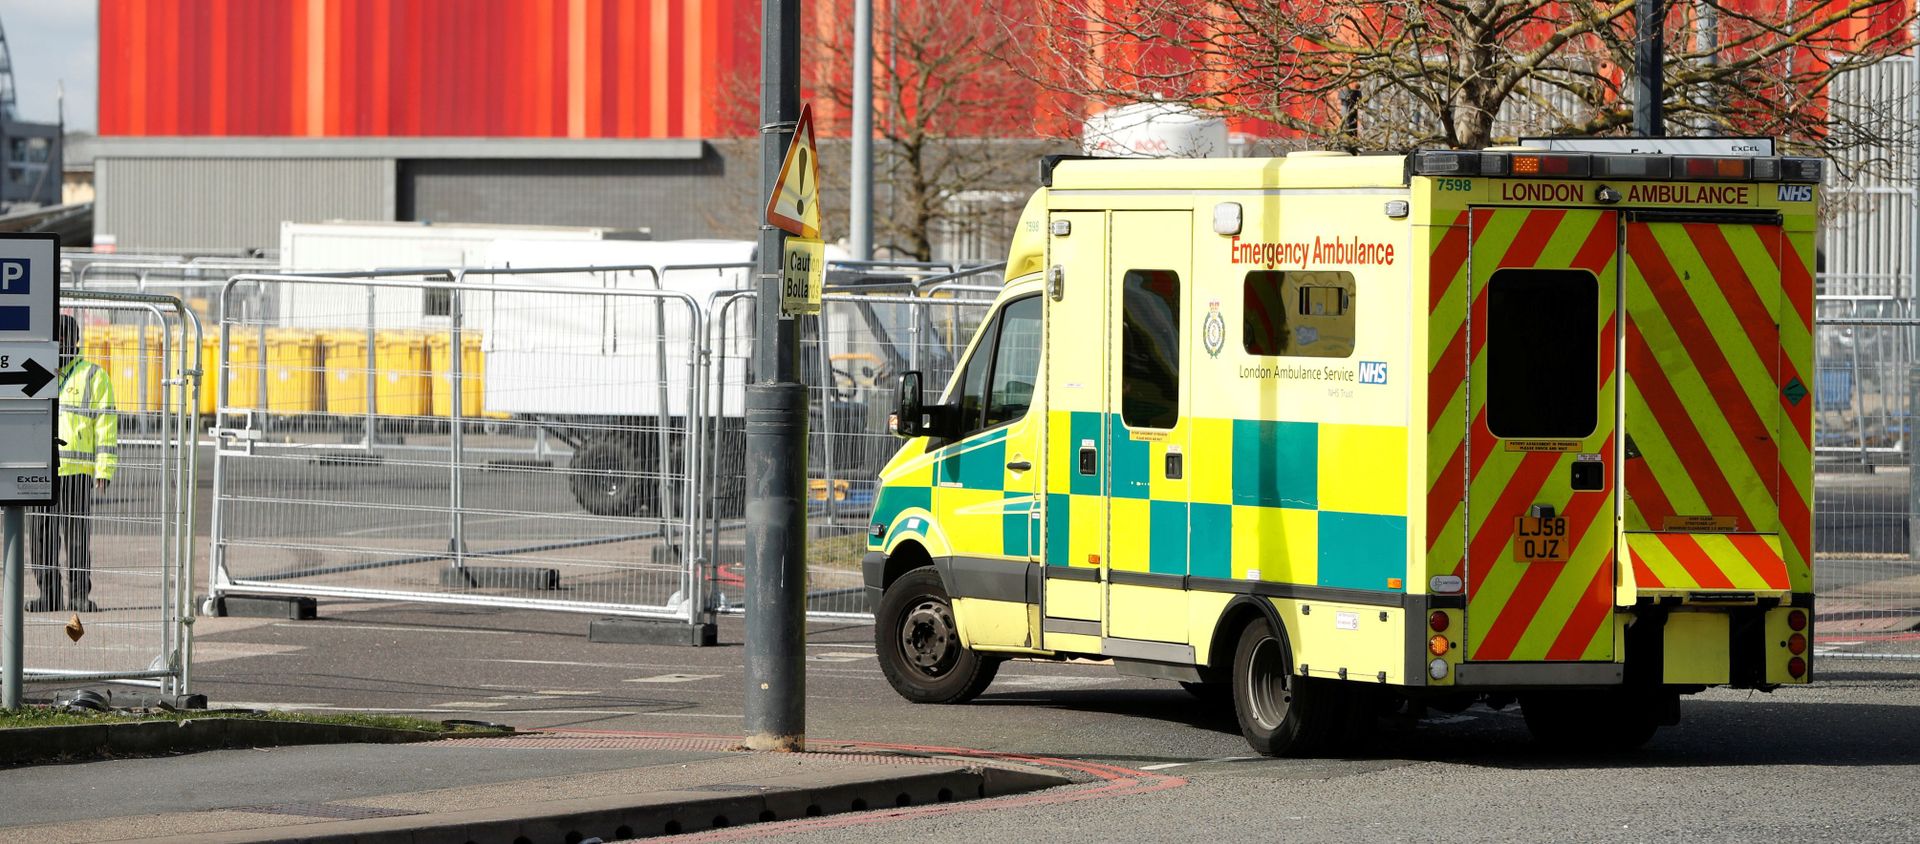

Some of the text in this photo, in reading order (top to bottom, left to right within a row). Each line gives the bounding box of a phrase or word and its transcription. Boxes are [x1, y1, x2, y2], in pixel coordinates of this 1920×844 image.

[1437, 178, 1472, 192] 7598
[1502, 182, 1749, 205] LONDON AMBULANCE
[1777, 185, 1812, 201] NHS
[1231, 235, 1394, 270] Emergency Ambulance
[1239, 364, 1354, 382] London Ambulance Service
[1358, 362, 1387, 384] NHS
[1328, 388, 1354, 398] NHS Trust
[1519, 518, 1565, 537] LJ58
[1524, 540, 1559, 558] OJZ
